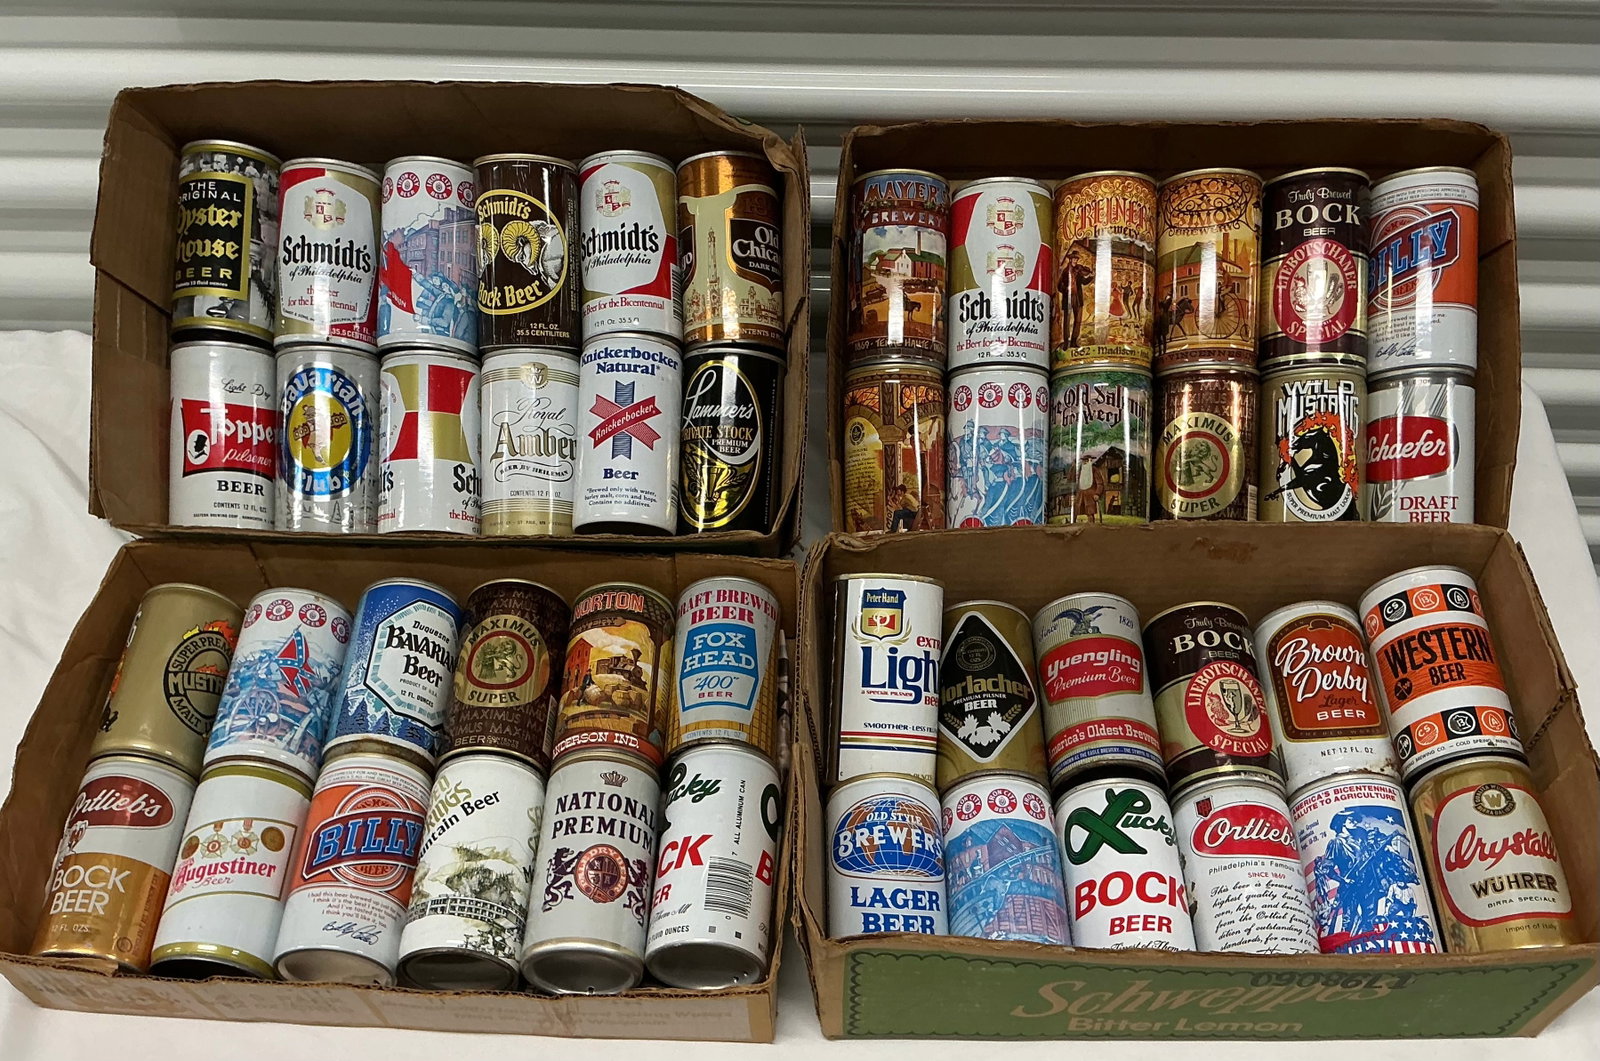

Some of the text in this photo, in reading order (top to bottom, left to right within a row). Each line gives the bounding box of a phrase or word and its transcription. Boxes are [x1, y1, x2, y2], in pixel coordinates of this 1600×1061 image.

[189, 181, 216, 191] THE
[426, 173, 452, 191] IRON CITY
[430, 190, 448, 200] BEER
[1288, 189, 1315, 204] Truly
[1316, 187, 1352, 200] Brewed
[477, 196, 531, 222] Schmidt's
[871, 211, 942, 227] BREWERY
[1274, 202, 1361, 231] BOCK
[580, 221, 660, 262] Schmidt's
[754, 226, 779, 249] Old
[1303, 227, 1336, 237] BEER
[282, 234, 371, 273] Schmidt's
[590, 252, 652, 269] Philadelphia
[732, 239, 781, 264] Chica
[1367, 219, 1452, 295] BILLY
[175, 267, 232, 280] BEER
[1276, 240, 1358, 291] LIEBOTSCHANER
[478, 280, 543, 308] Bock Beer
[620, 297, 665, 310] Bicentennial
[959, 289, 1045, 323] Schidt's
[975, 321, 1039, 337] Philadelphia
[1286, 318, 1347, 341] SPECIAL
[580, 346, 679, 371] Knickerbocker
[1097, 345, 1136, 357] Madison
[1167, 349, 1242, 361] VINCENNES
[250, 384, 271, 400] Dry
[280, 371, 365, 416] Bavarian
[1064, 383, 1091, 409] Old
[1282, 379, 1355, 397] WILD
[595, 404, 655, 441] Knickerbocker
[681, 425, 753, 441] PRIVATE STOCK
[1162, 416, 1234, 446] MAXIMUS
[490, 422, 577, 463] Amber
[711, 438, 749, 448] PREMIUM
[719, 446, 742, 454] BEER
[1367, 429, 1446, 464] Schaefer
[602, 468, 639, 480] Beer
[217, 480, 265, 497] BEER
[1170, 497, 1221, 513] SUPER
[1286, 492, 1326, 520] SUPER PREMIUM
[1399, 496, 1459, 510] DRAFT
[1408, 511, 1451, 523] BEER
[574, 591, 645, 619] NORTON
[677, 589, 777, 622] DRAFT BREWED
[866, 592, 899, 604] Peter Hand
[691, 606, 755, 626] BEER
[1183, 616, 1214, 629] Truly
[468, 618, 541, 649] MAXIMUS
[692, 631, 746, 651] FOX
[1172, 629, 1256, 660] BOCK
[171, 640, 201, 671] SUPER
[384, 624, 457, 673] BAVARIAN
[1208, 650, 1241, 660] BEER
[1274, 637, 1369, 678] Brown
[1383, 627, 1495, 679] WESTERN
[402, 654, 443, 688] Beer
[683, 651, 755, 673] HEAD
[1045, 648, 1141, 687] Yuengling
[861, 646, 940, 705] Ligh
[1051, 665, 1137, 697] Premium Beer
[1291, 665, 1368, 703] Derby
[1428, 662, 1467, 687] BEER
[467, 690, 520, 704] SUPER
[698, 691, 734, 699] BEER
[1187, 661, 1268, 715] LIEBOTSCHANER
[953, 693, 981, 706] PREMIUM
[964, 698, 998, 712] BEER
[1318, 694, 1360, 708] Lager
[173, 697, 201, 728] MALT
[459, 708, 522, 723] MAXIMUS
[1316, 709, 1367, 722] BEER
[454, 734, 487, 747] BEER
[613, 733, 640, 749] IND.
[1086, 723, 1124, 739] Oldest
[1209, 734, 1270, 754] SPECIAL
[1320, 748, 1337, 757] NET
[666, 762, 722, 804] ucky
[988, 789, 1017, 804] IRON CITY
[1292, 784, 1398, 816] AMERICA'S BICENTENNIAL
[1293, 791, 1397, 822] SALUTE AGRICULTURE
[554, 791, 656, 832] NATIONAL
[735, 794, 746, 830] ALUMINUM
[866, 811, 923, 827] OLD STYLE
[418, 813, 460, 860] untain
[460, 791, 500, 817] Beer
[551, 815, 654, 856] PREMIUM
[1064, 788, 1177, 866] Lucky
[313, 816, 424, 866] BILLY
[838, 825, 944, 859] BREWERS
[657, 834, 714, 879] CK
[175, 856, 277, 886] Augustiner
[360, 865, 389, 875] BEER
[1208, 860, 1295, 876] Philadelphia's Famous
[1247, 871, 1269, 879] SINCE
[51, 865, 132, 894] BOCK
[191, 876, 236, 889] Beer
[1209, 879, 1293, 898] This beer brewed
[1470, 872, 1560, 900] WÜHRER
[50, 889, 110, 916] BEER
[850, 886, 940, 912] LAGER
[1075, 870, 1190, 922] BOCK
[1212, 889, 1278, 909] highest quality
[1261, 901, 1279, 909] and
[1487, 896, 1557, 909] BIRRA SPECIALE
[664, 925, 690, 935] OUNCES
[861, 912, 936, 935] BEER
[1108, 914, 1173, 936] BEER
[1215, 911, 1287, 934] from Ortlieb
[1217, 921, 1303, 941] dition outstanding
[1219, 935, 1263, 952] standards,
[1010, 979, 1393, 1019] Schweppes
[1067, 1016, 1304, 1034] Bitter Lemon
